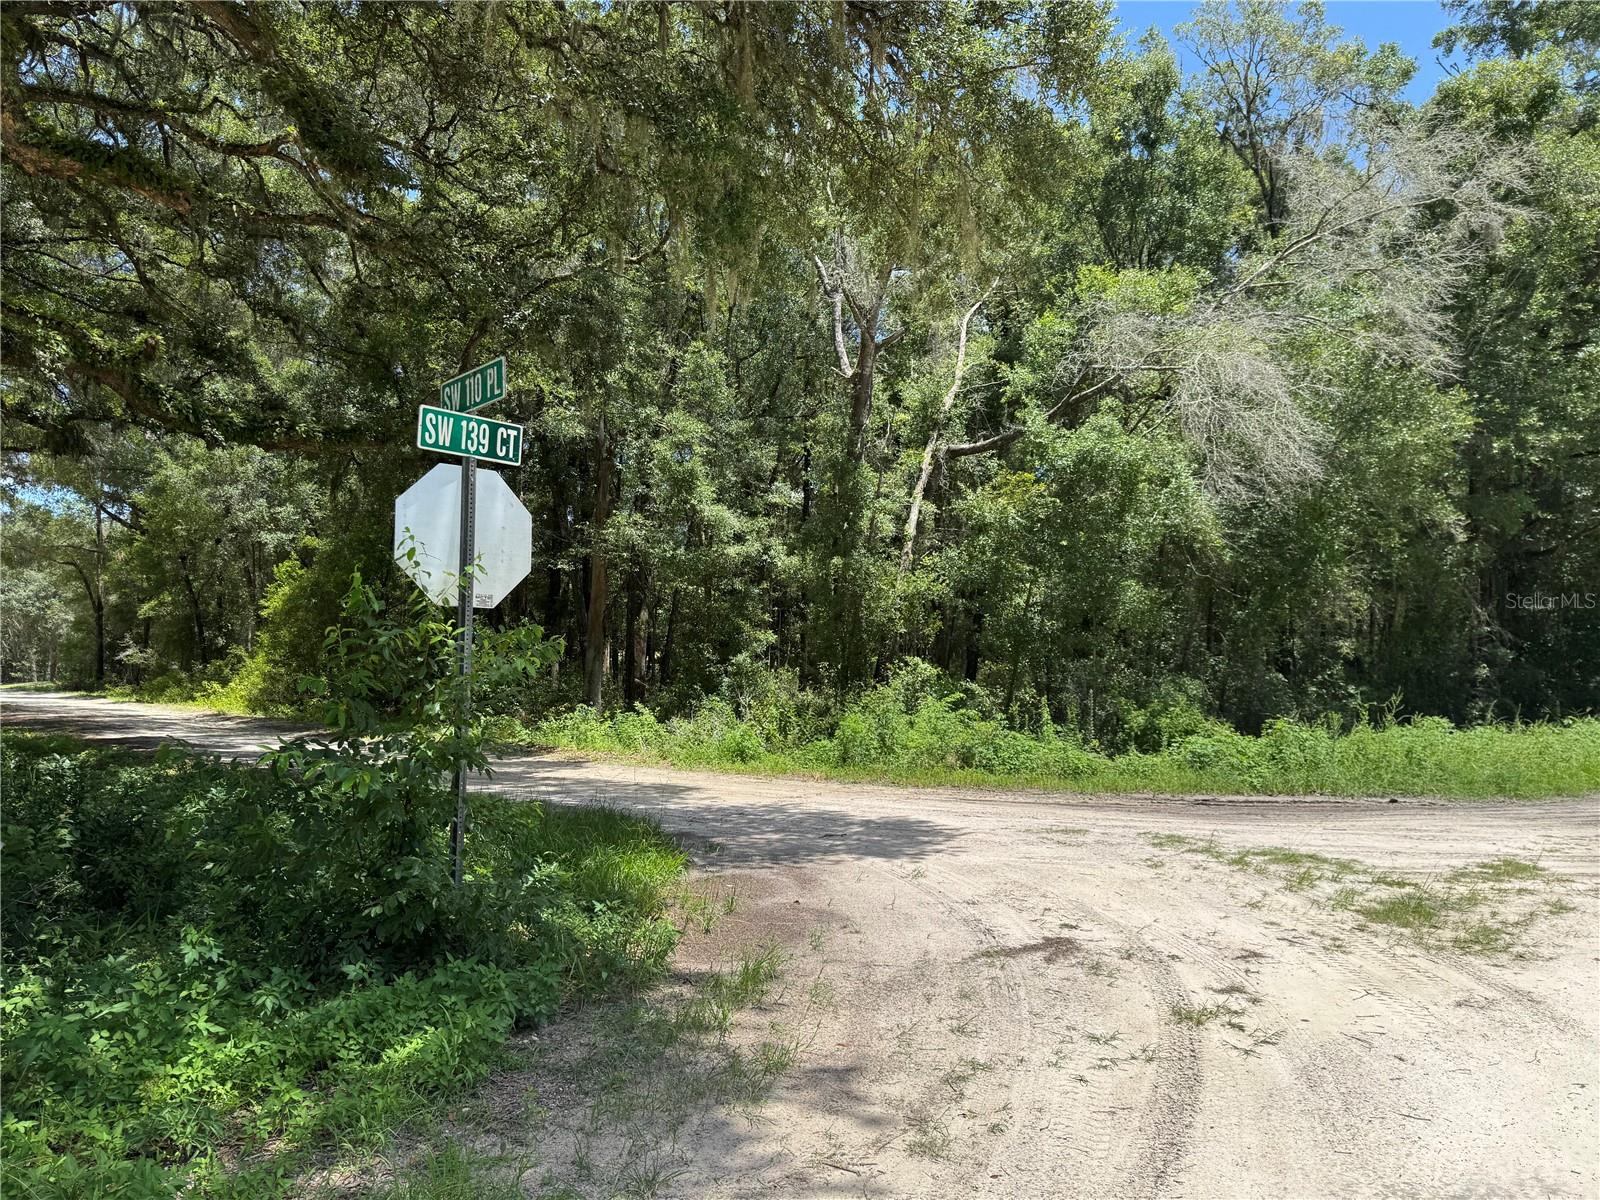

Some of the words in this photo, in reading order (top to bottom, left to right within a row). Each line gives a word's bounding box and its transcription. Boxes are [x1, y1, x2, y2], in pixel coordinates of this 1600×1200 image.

[444, 382, 461, 411] SW
[465, 373, 482, 406] 110
[487, 366, 501, 398] PL
[425, 413, 454, 447] SW
[460, 420, 490, 454] 139
[496, 427, 518, 458] CT
